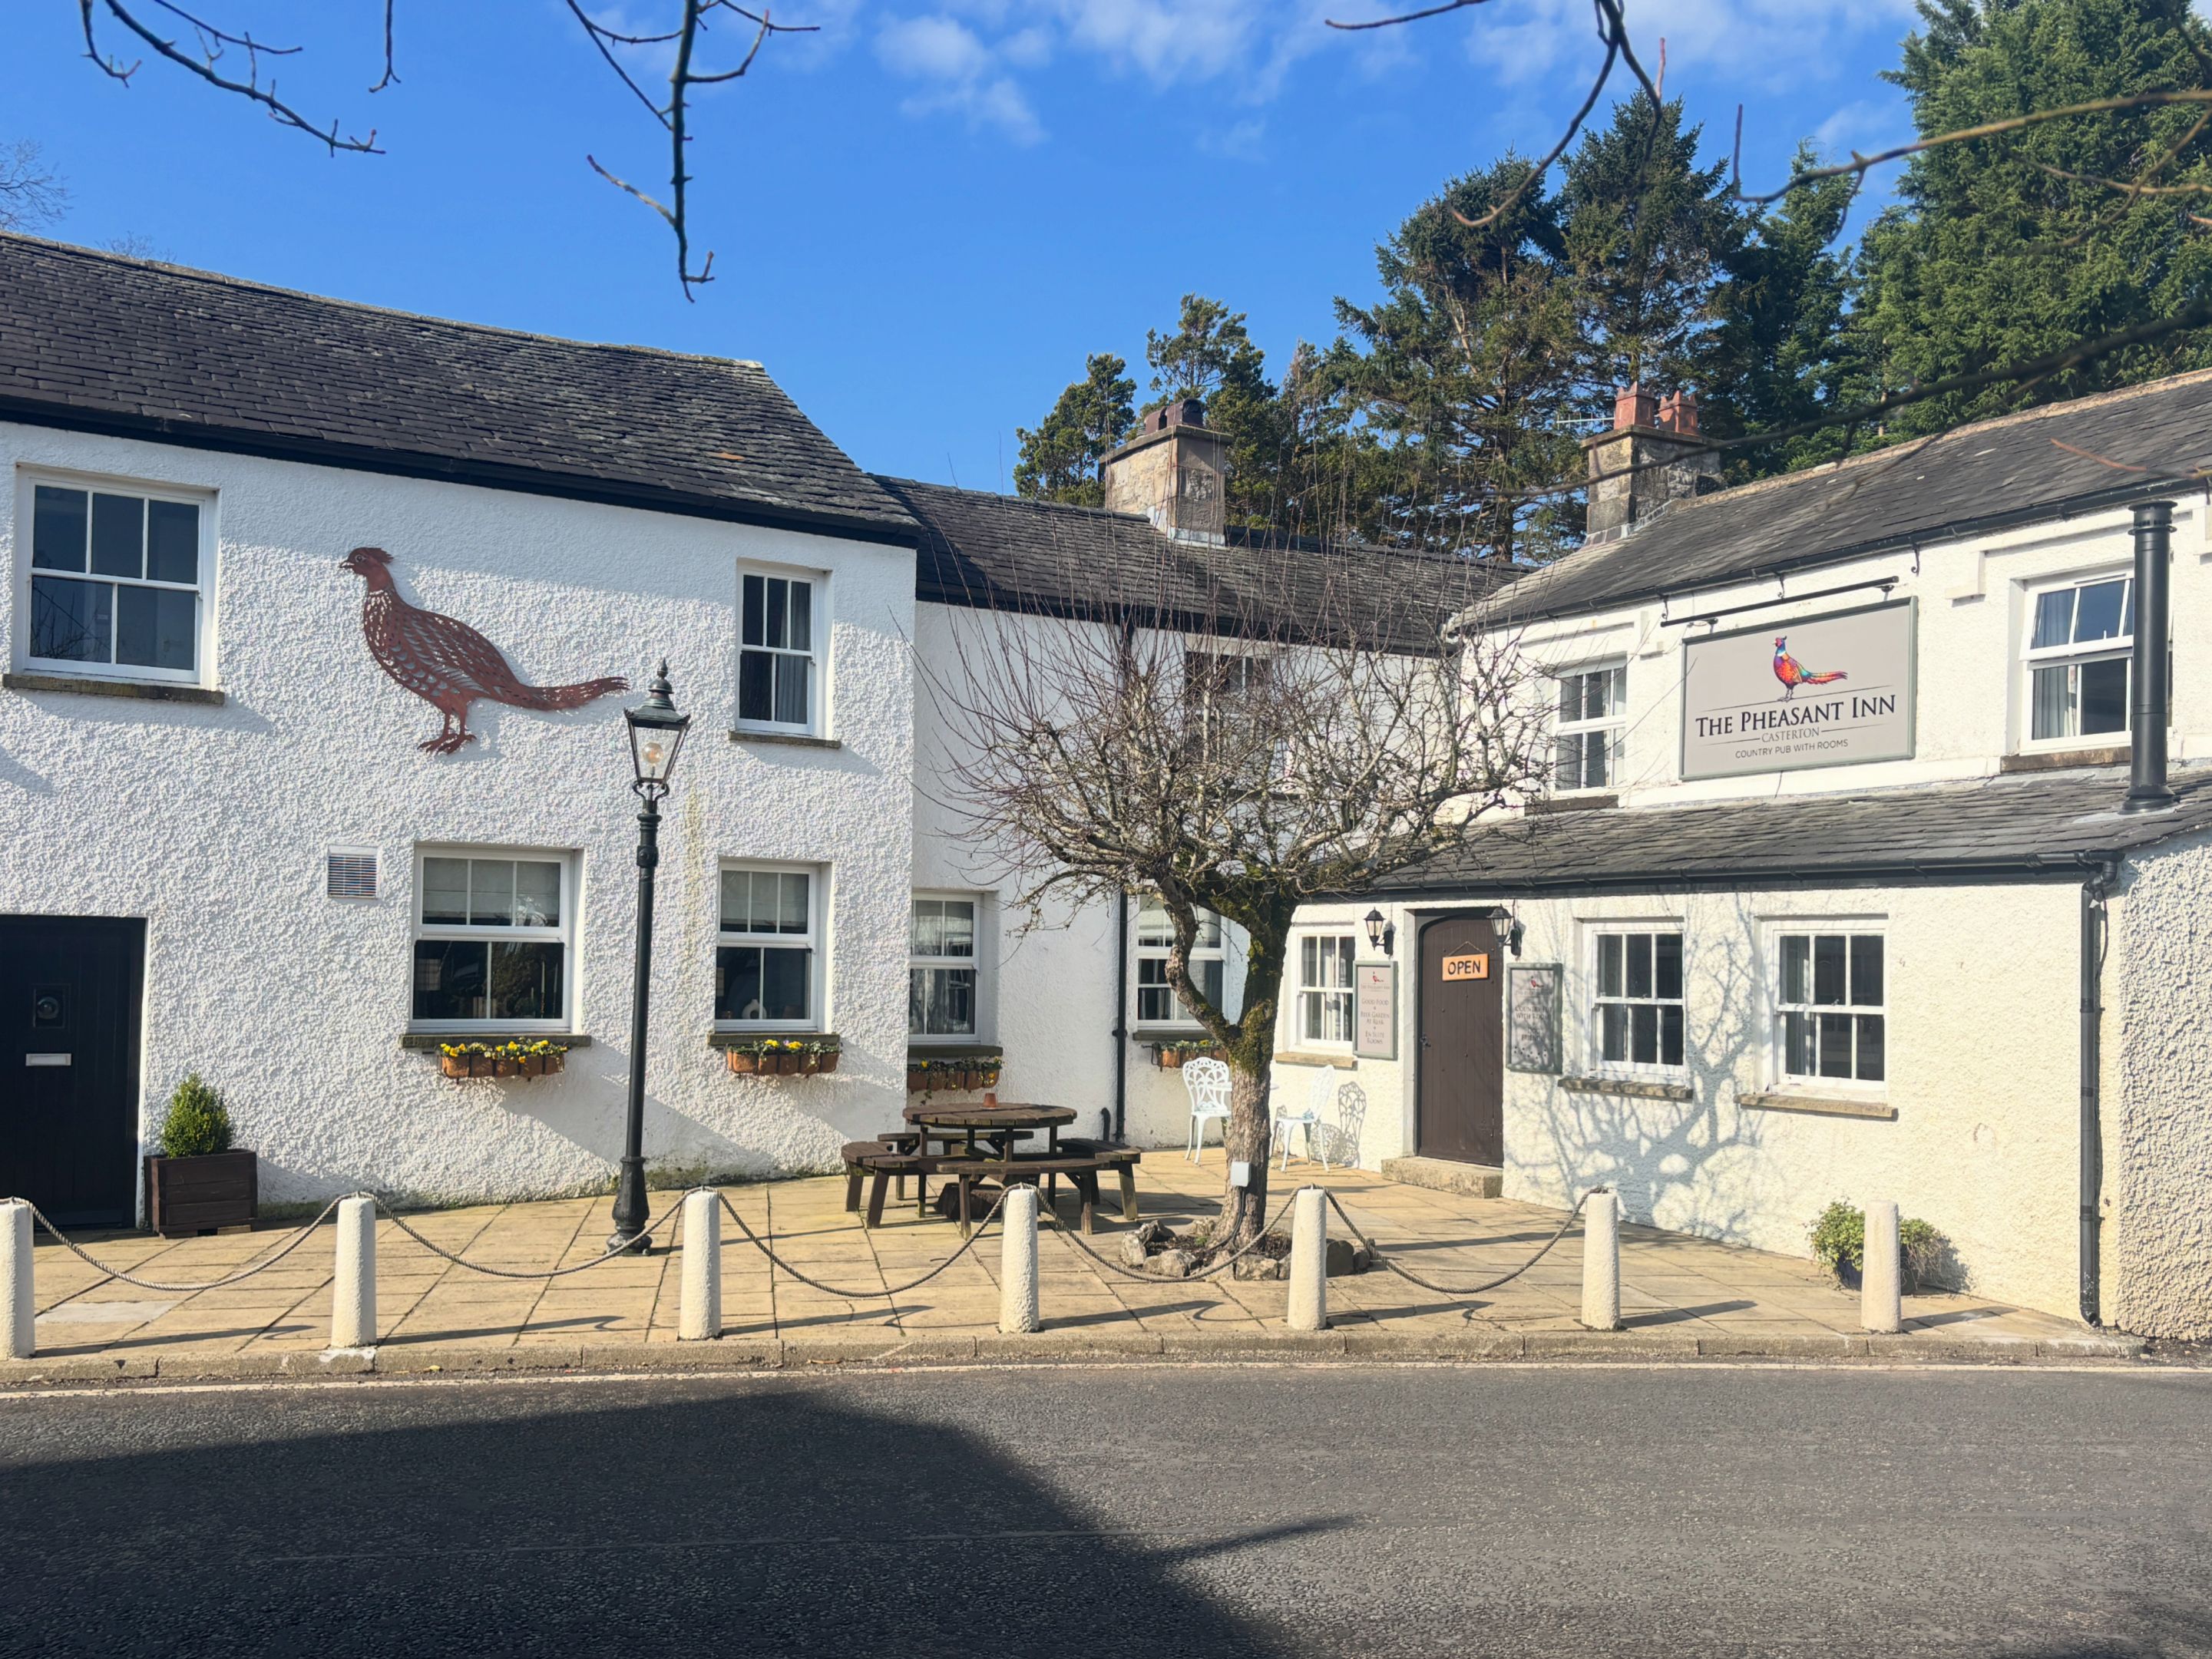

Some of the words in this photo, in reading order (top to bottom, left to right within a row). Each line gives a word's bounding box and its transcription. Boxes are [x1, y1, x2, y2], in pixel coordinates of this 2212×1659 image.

[1695, 716, 1733, 737] THE
[1741, 702, 1844, 732] PHEASANT
[1853, 695, 1896, 718] INN
[1761, 727, 1820, 742] CASTERTON
[1735, 748, 1773, 758] COUNTRY
[1775, 745, 1791, 754] PUB
[1794, 742, 1815, 752] WITH
[1817, 739, 1848, 749] ROOMS
[1448, 960, 1481, 975] OPEN
